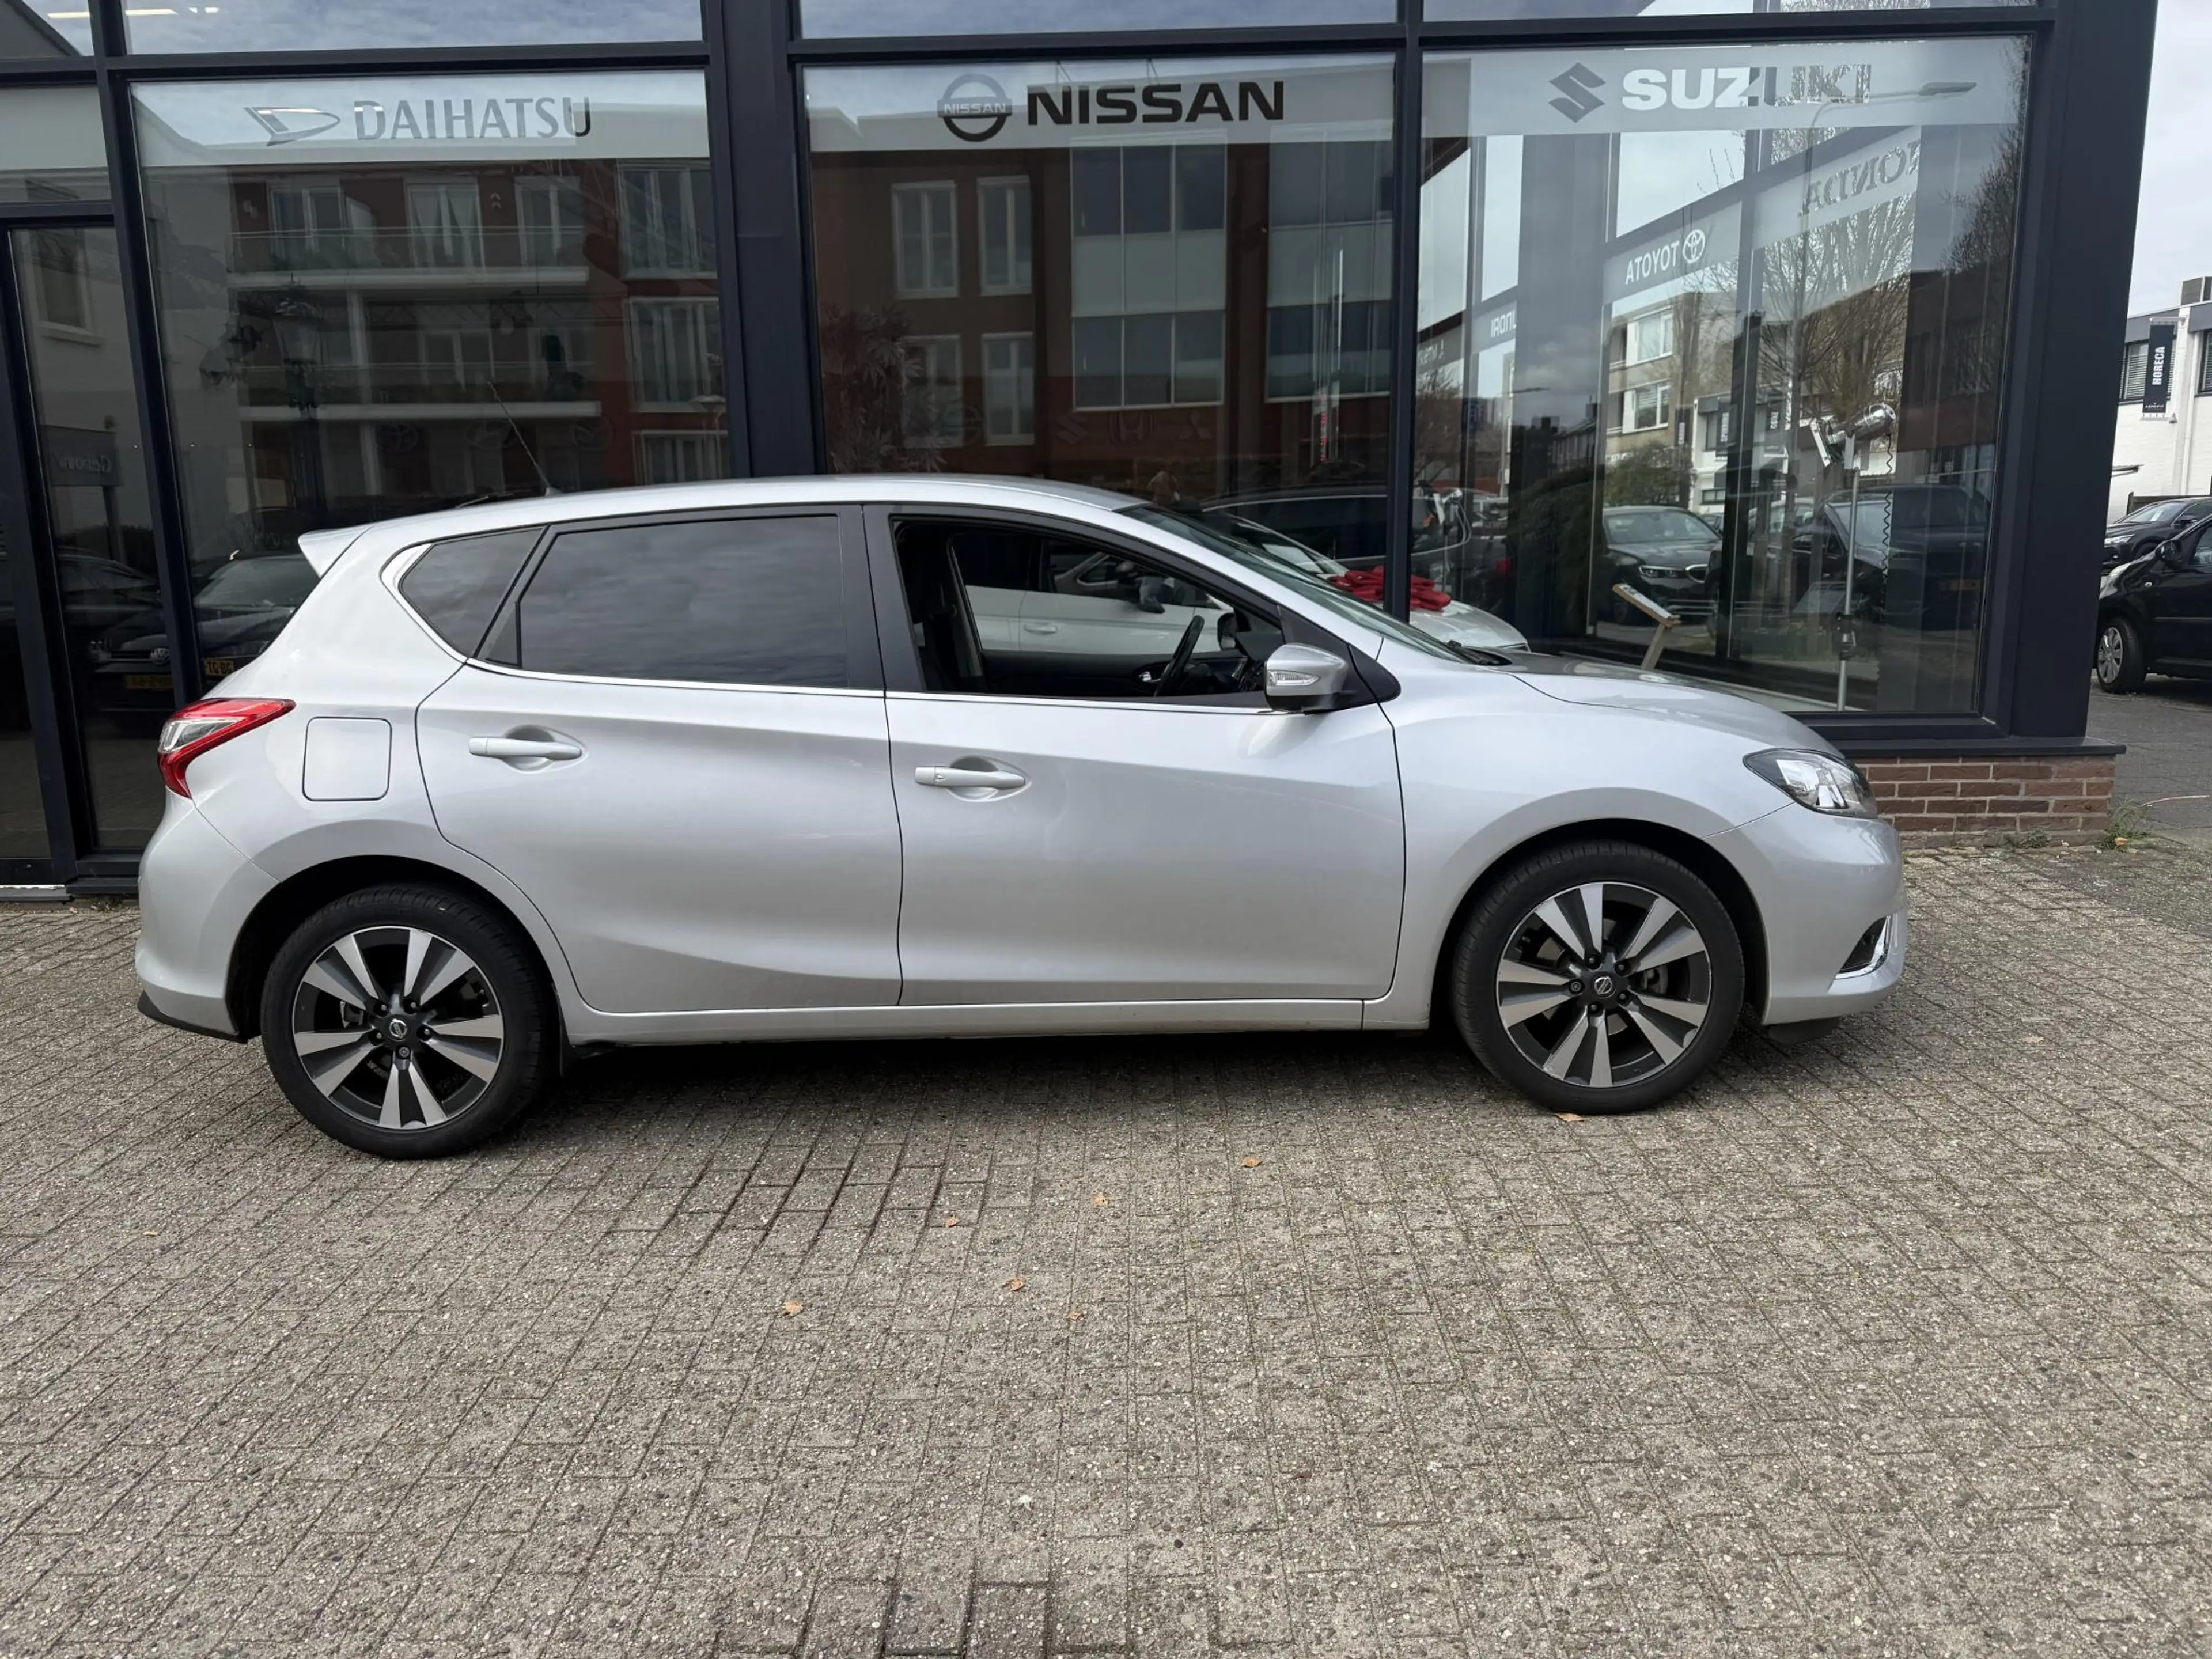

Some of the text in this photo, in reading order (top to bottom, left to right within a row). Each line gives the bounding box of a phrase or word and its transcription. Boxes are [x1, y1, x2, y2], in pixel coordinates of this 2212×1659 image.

[944, 103, 1006, 114] NISSAN
[1028, 81, 1285, 126] NISSAN
[1622, 63, 1871, 109] SUZUKI
[354, 96, 592, 141] DAIHATSU
[2152, 346, 2165, 385] HORECA
